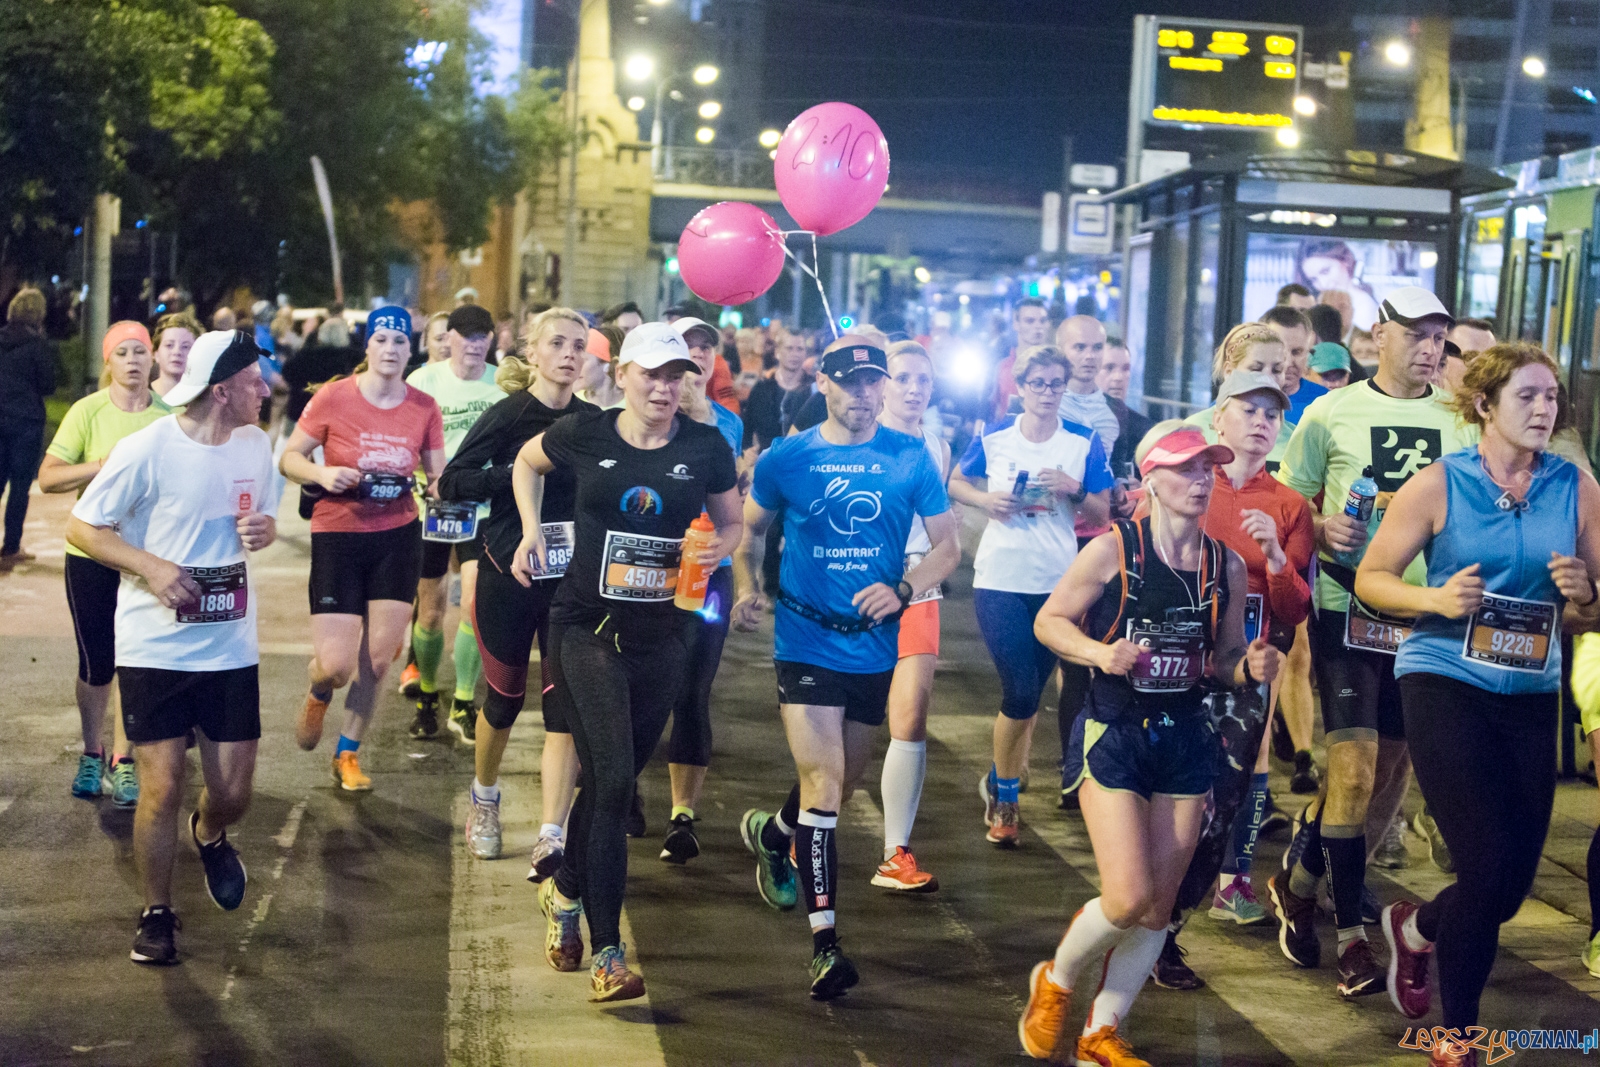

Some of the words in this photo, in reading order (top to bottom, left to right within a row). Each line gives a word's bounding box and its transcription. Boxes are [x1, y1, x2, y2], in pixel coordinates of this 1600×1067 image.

[792, 116, 877, 180] 2:10
[809, 464, 865, 473] PACEMAKER
[370, 485, 402, 498] 2992
[436, 518, 463, 533] 1476
[825, 547, 880, 558] KONTRAKT
[624, 567, 667, 588] 4503
[200, 592, 235, 613] 1880
[1366, 622, 1404, 643] 2715
[1491, 631, 1534, 656] 9226
[1150, 656, 1190, 677] 3772
